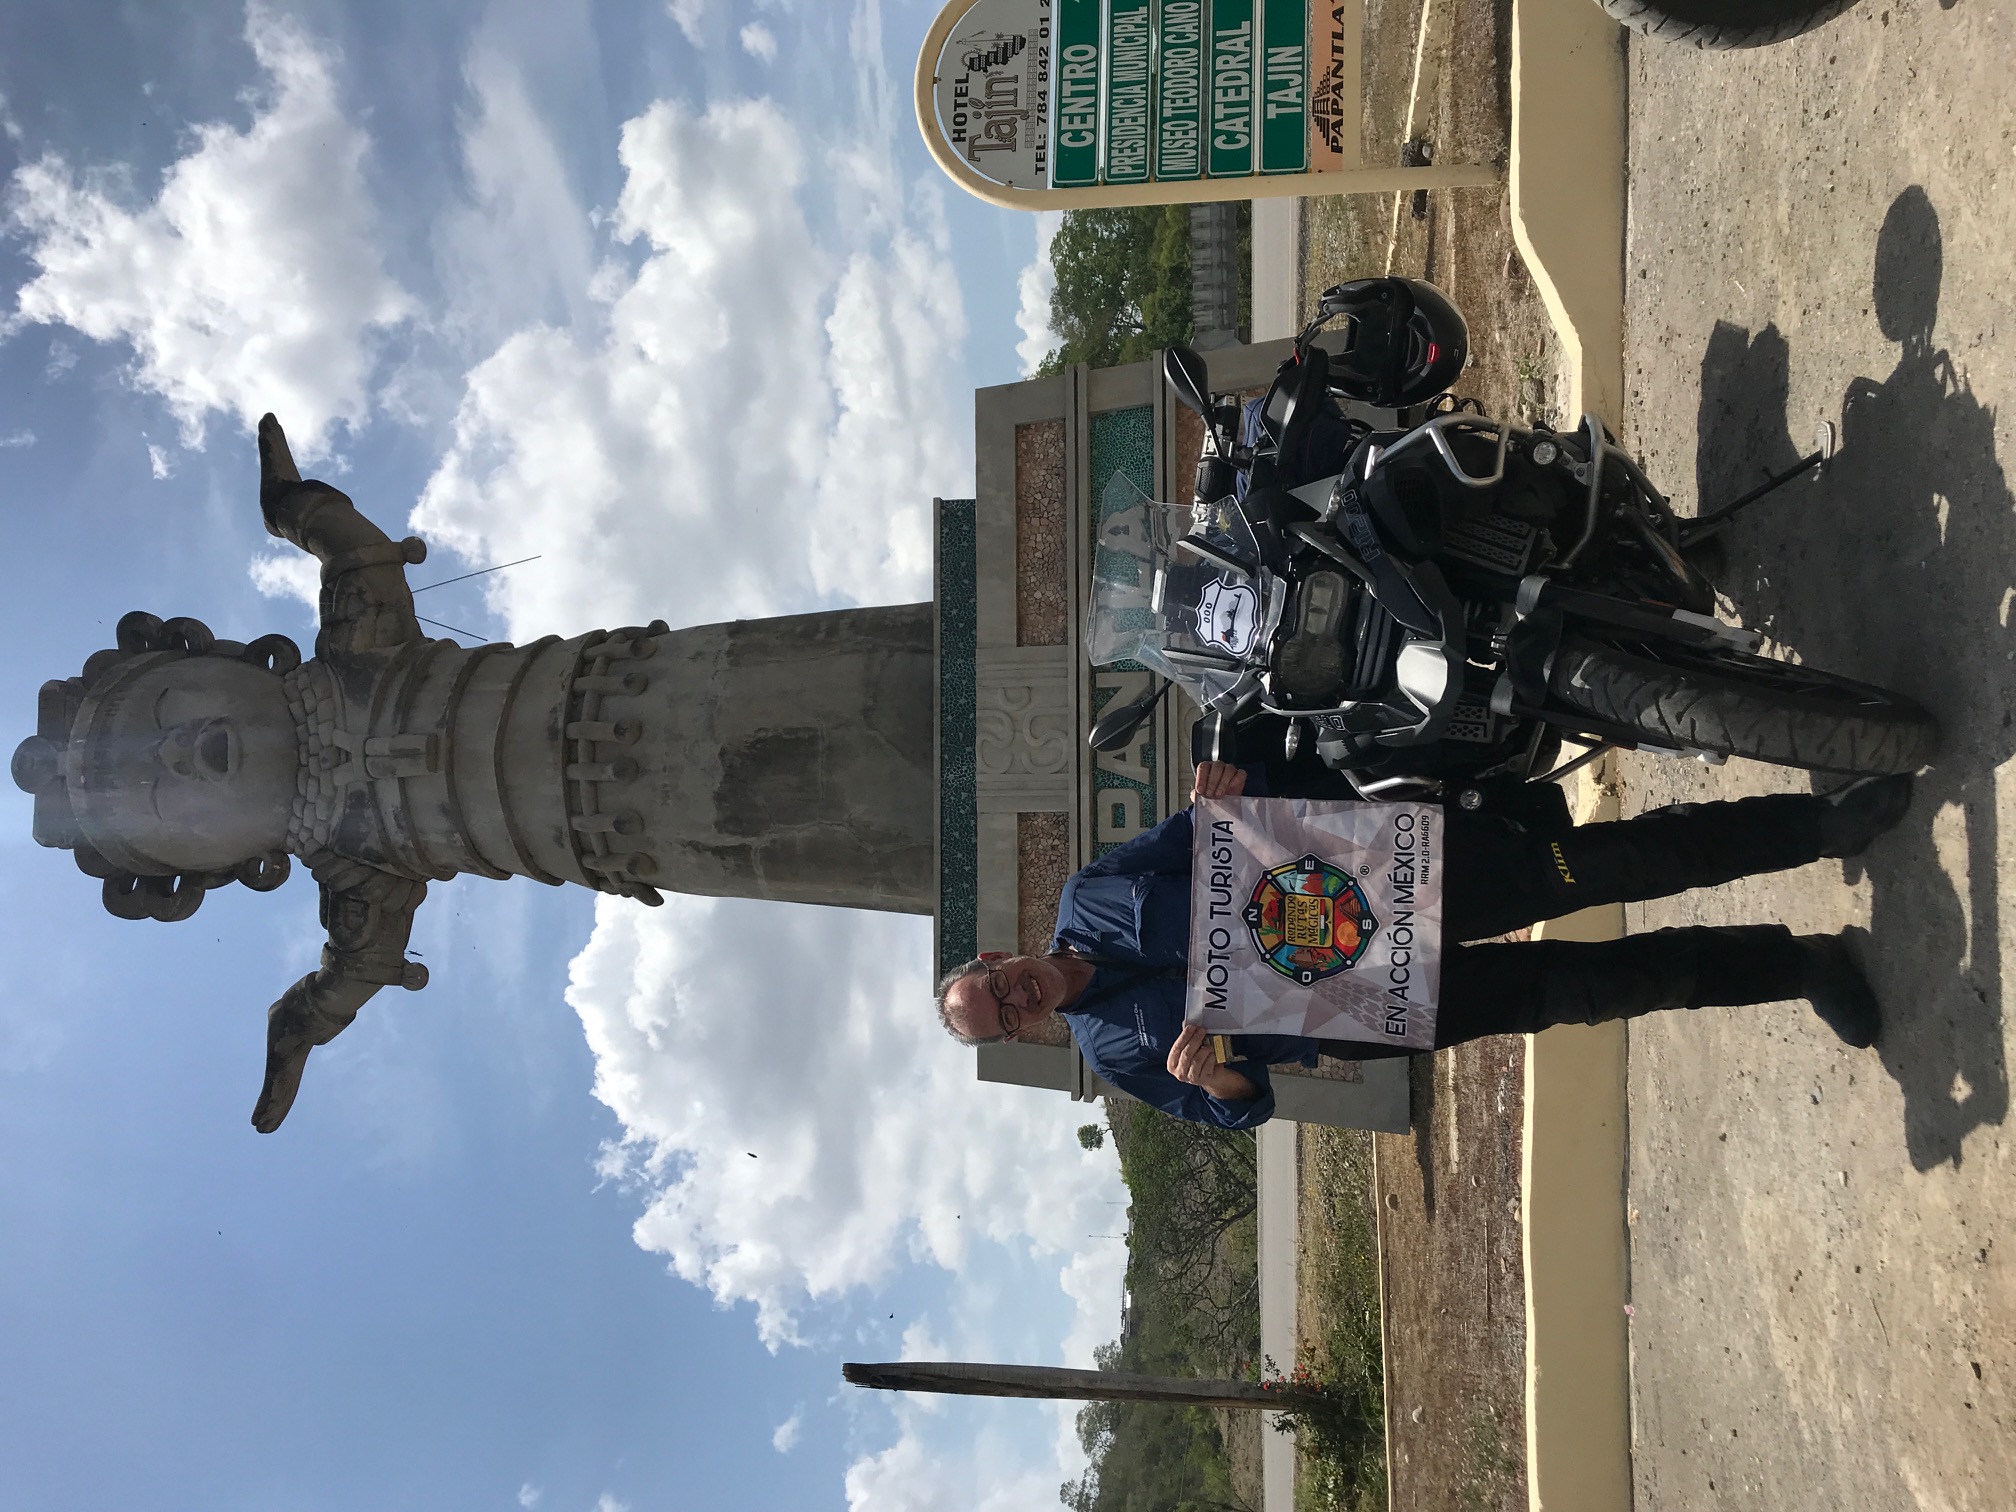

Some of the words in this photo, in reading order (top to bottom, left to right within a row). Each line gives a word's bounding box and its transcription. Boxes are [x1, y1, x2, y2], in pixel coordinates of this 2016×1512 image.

[1039, 17, 1050, 39] 01
[1112, 6, 1148, 82] MUNICIPAL
[1164, 2, 1200, 44] CANO
[1038, 46, 1049, 82] 842
[1162, 47, 1199, 118] TEODORO
[1214, 20, 1251, 150] CATEDRAL
[1267, 45, 1303, 120] TAJIN
[1330, 6, 1345, 154] PAPANTLA
[952, 72, 970, 143] HOTEL
[1037, 89, 1048, 126] 784
[1060, 44, 1097, 148] CENTRO
[1035, 134, 1047, 175] TEL:
[1110, 84, 1147, 175] PRESIDENCIA
[1161, 120, 1198, 171] MUSEO
[1209, 820, 1234, 920] TURISTA
[1304, 860, 1315, 871] E
[1387, 813, 1415, 904] MÉXICO
[1420, 865, 1430, 885] RRM
[1551, 842, 1577, 884] Klim
[1248, 908, 1258, 922] N
[1362, 919, 1372, 930] S
[1204, 927, 1231, 1010] MOTO
[1386, 911, 1414, 1001] ACCIÓN
[1385, 1005, 1408, 1037] EN
